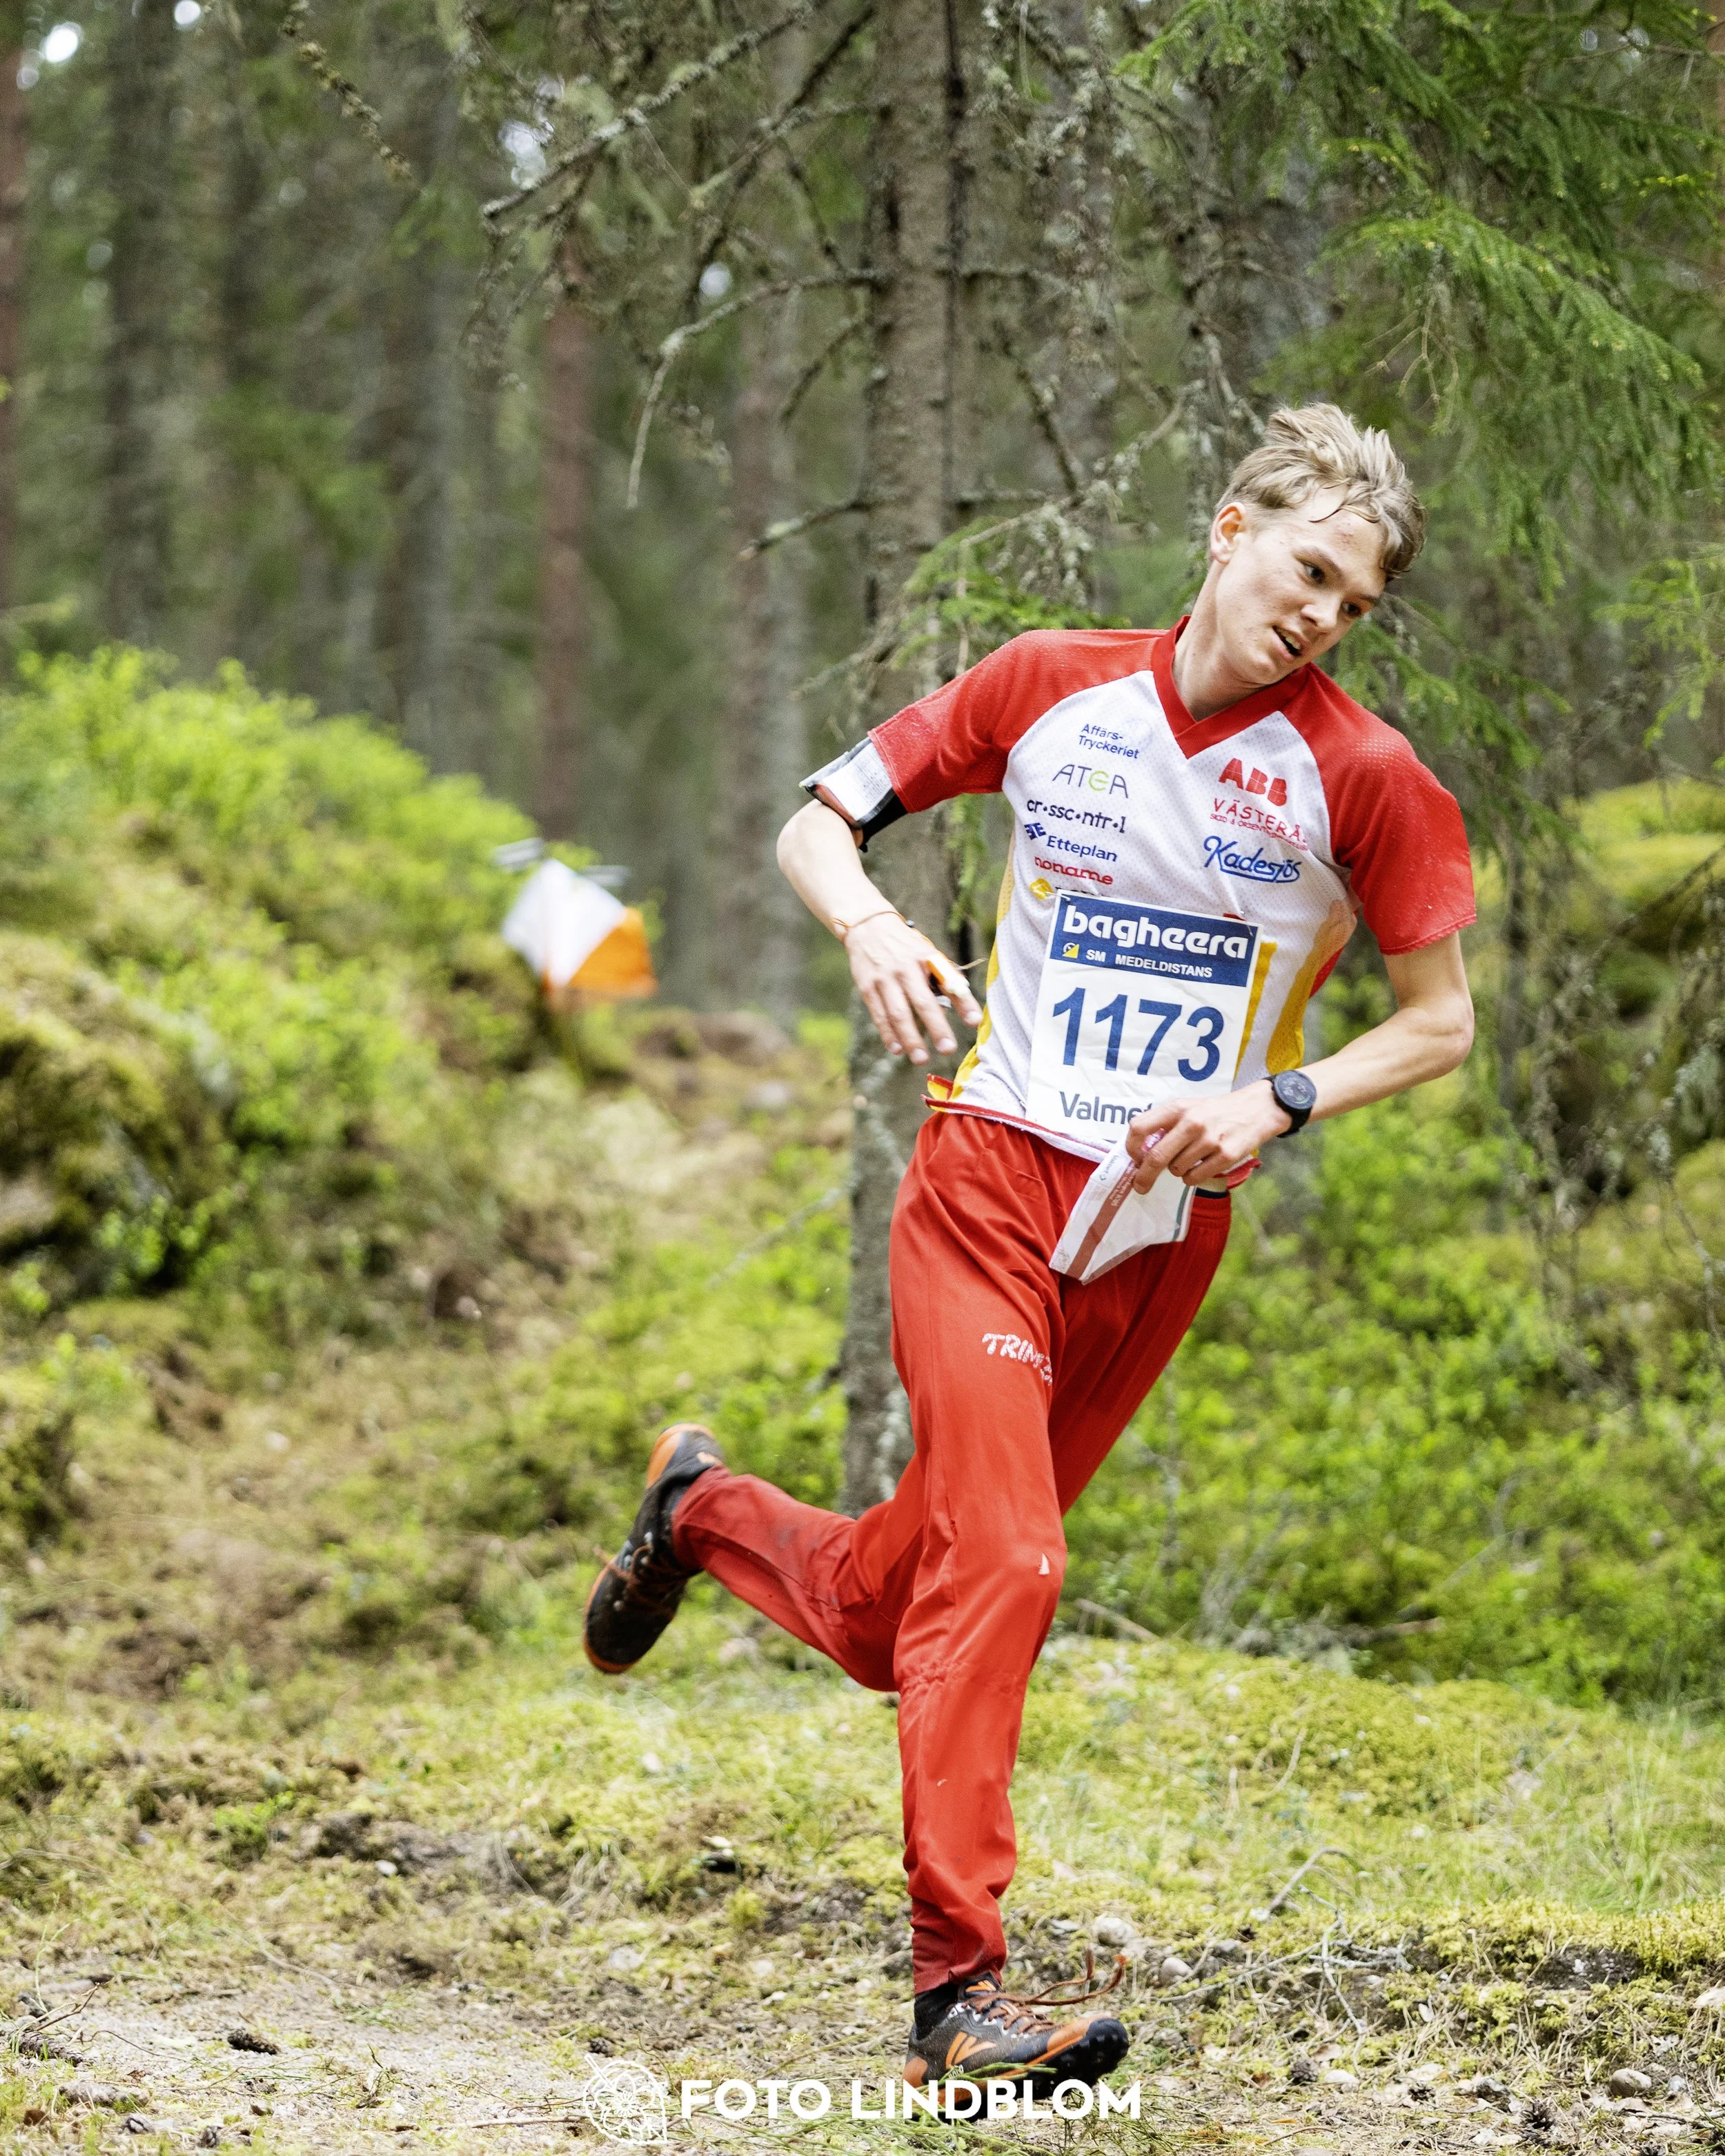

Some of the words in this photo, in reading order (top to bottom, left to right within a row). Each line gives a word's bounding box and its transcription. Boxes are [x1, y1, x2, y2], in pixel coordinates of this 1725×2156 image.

[1078, 735, 1140, 759] Tryckeriet
[1081, 724, 1123, 740] Affärs-
[1052, 764, 1129, 799] ATEA
[1219, 758, 1287, 807] ABB
[1214, 798, 1308, 842] VÄSTERÅ
[1046, 835, 1118, 862] Etteplan
[1203, 835, 1303, 883] Kadesjös
[1034, 856, 1114, 885] noname
[1063, 904, 1248, 959] bagheera
[1085, 949, 1106, 962] SM
[1115, 954, 1212, 978] MEDELDISTANS
[1053, 987, 1224, 1082] 1173
[1059, 1091, 1152, 1125] Valme
